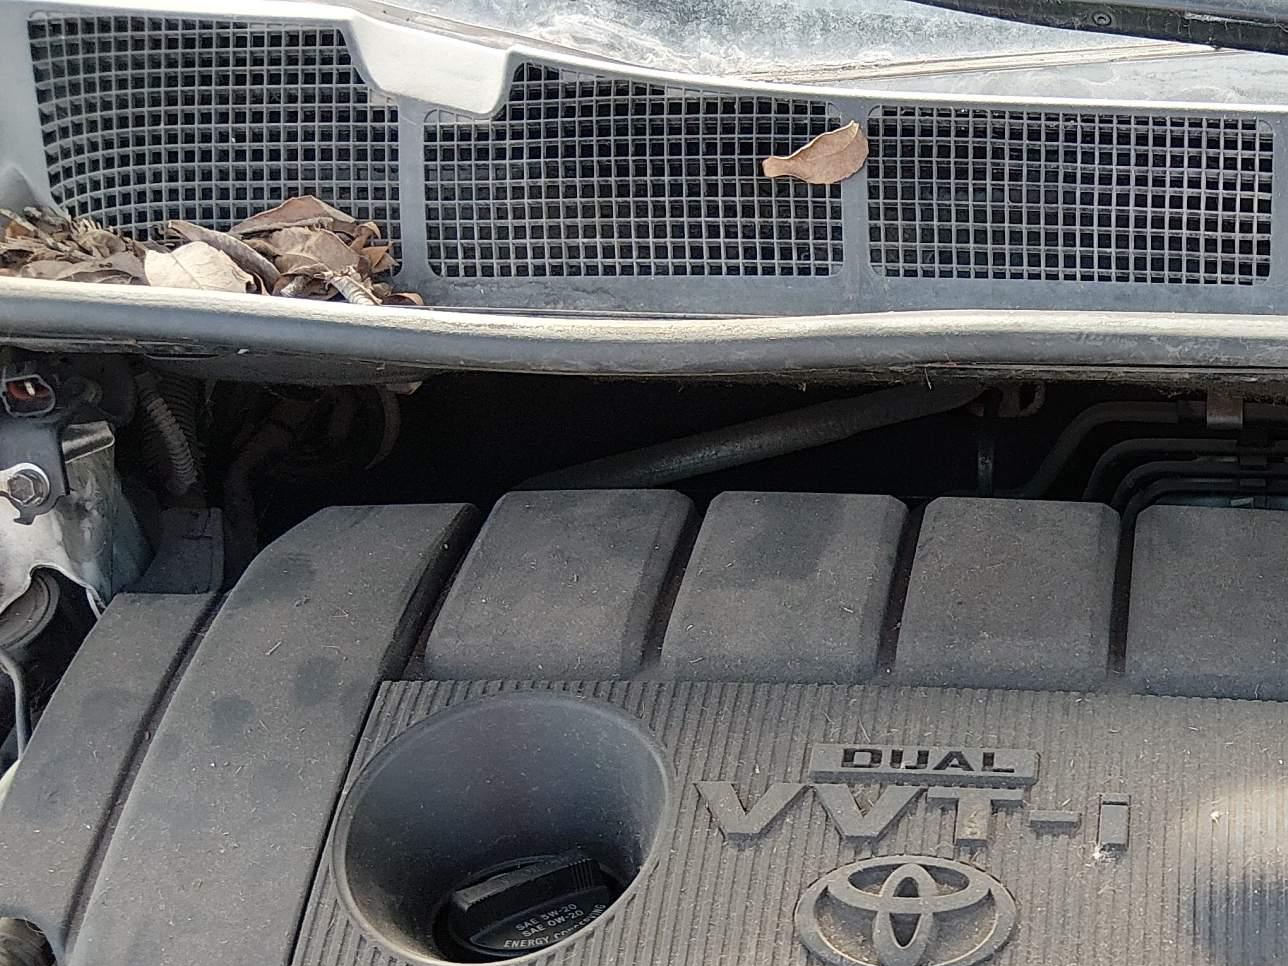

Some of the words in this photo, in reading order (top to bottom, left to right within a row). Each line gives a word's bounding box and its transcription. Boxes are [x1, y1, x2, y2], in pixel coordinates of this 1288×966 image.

[841, 747, 1015, 773] DUAL
[515, 917, 539, 931] SAE
[540, 903, 577, 919] 5W-20
[522, 924, 546, 938] SAE
[504, 936, 550, 948] ENERGY
